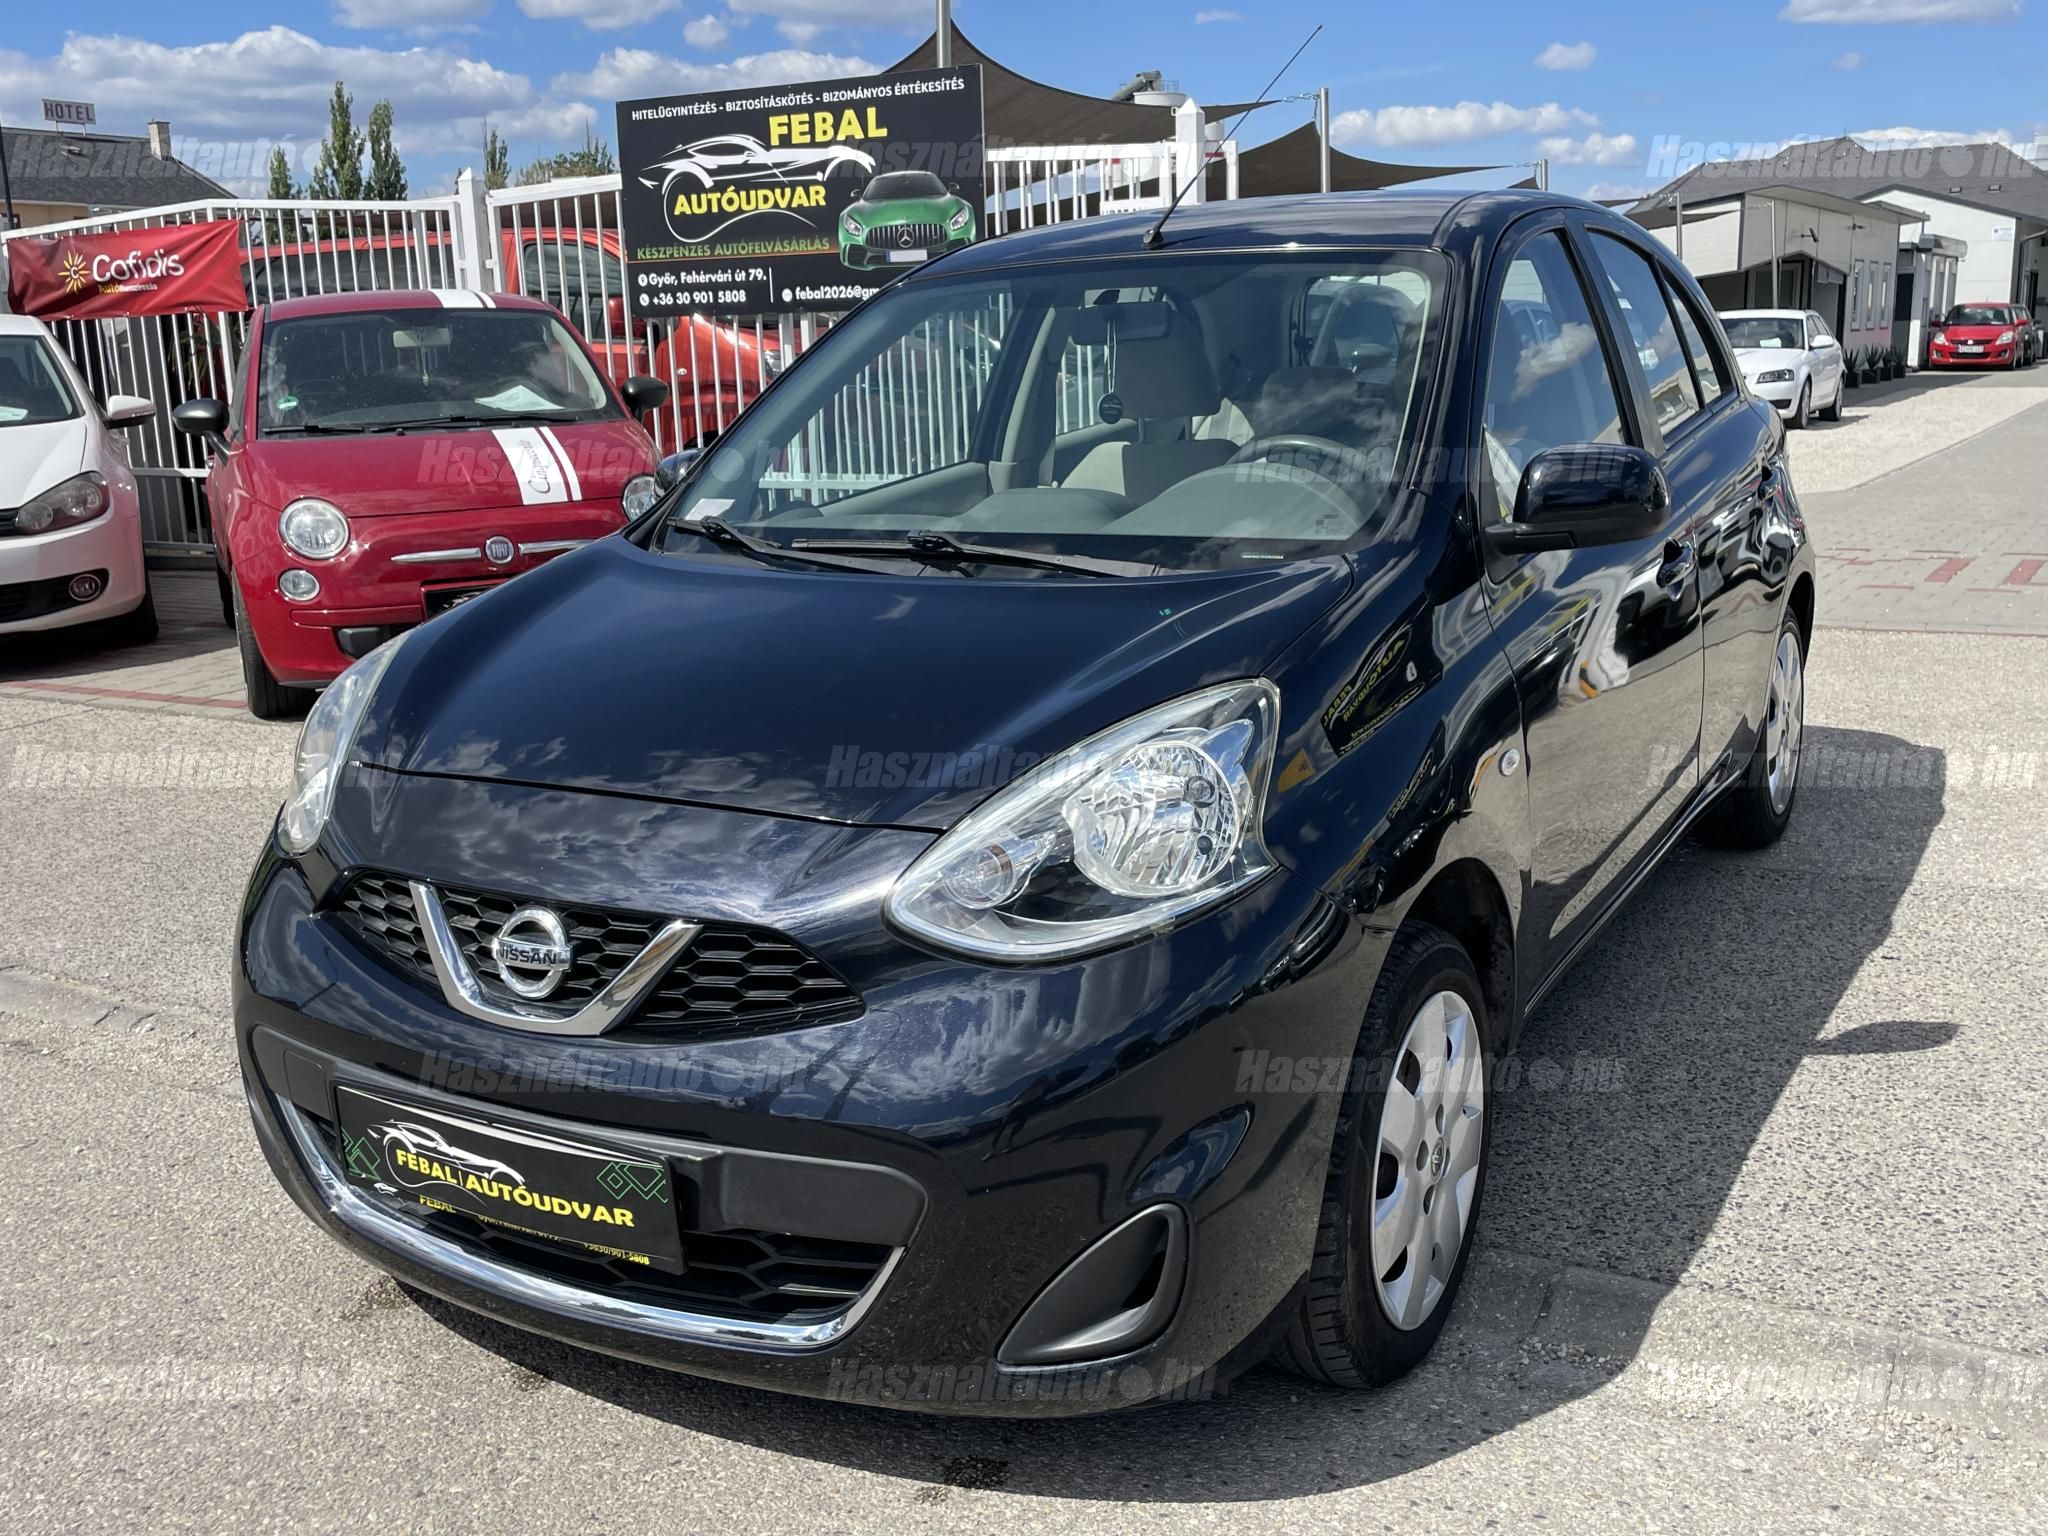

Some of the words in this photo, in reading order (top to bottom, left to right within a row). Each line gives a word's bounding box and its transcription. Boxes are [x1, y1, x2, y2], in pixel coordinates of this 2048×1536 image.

[43, 102, 95, 122] HOTEL
[632, 101, 717, 121] HITELÜGYINTÉZÉS
[725, 93, 814, 113] BIZTOSÍTÁSKÖTÉS
[822, 86, 892, 103] BIZOMÁNYOS
[894, 78, 965, 96] ÉRTÉKESÍTÉS
[768, 106, 888, 147] FEBAL
[673, 184, 826, 216] AUTÓUDVAR
[637, 245, 711, 261] KÉSZPÉNZES
[714, 235, 831, 256] AUTÓFELVÁSÁRLÁS
[92, 248, 185, 283] Cofidis
[649, 273, 679, 288] Győr,
[680, 268, 732, 284] Fehérvári
[734, 270, 747, 282] út
[748, 268, 767, 281] 79.
[652, 292, 674, 305] +36
[676, 292, 691, 303] 30
[693, 291, 714, 303] 901
[718, 289, 747, 302] 5808
[497, 944, 557, 965] NISSAN
[395, 1149, 458, 1185] FEBAL
[465, 1174, 635, 1228] AUTÓUDVAR
